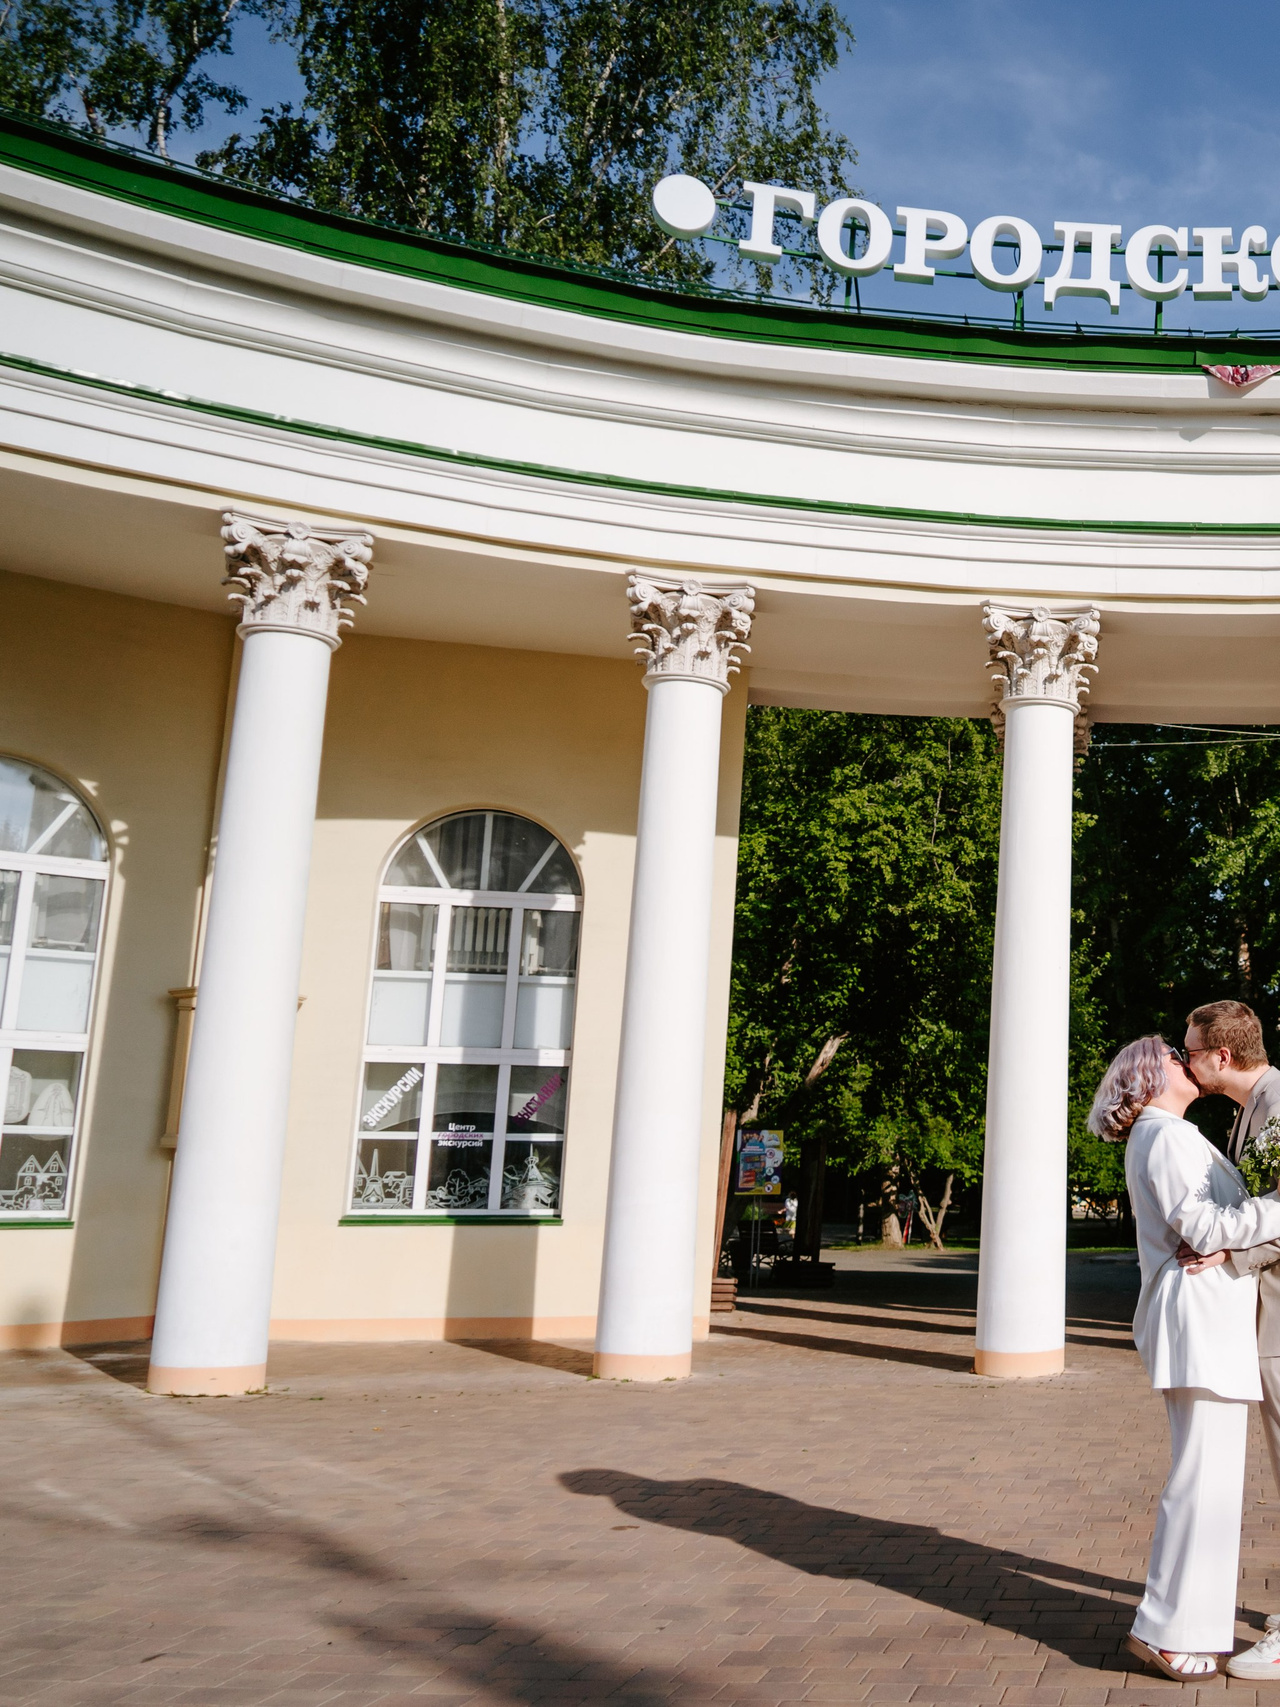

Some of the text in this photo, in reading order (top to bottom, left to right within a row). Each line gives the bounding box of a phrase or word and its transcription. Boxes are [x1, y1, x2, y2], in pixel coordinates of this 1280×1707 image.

[362, 1066, 424, 1127] ЭКСКУРСИИ
[448, 1122, 476, 1132] Центр
[437, 1139, 483, 1149] экскурсий
